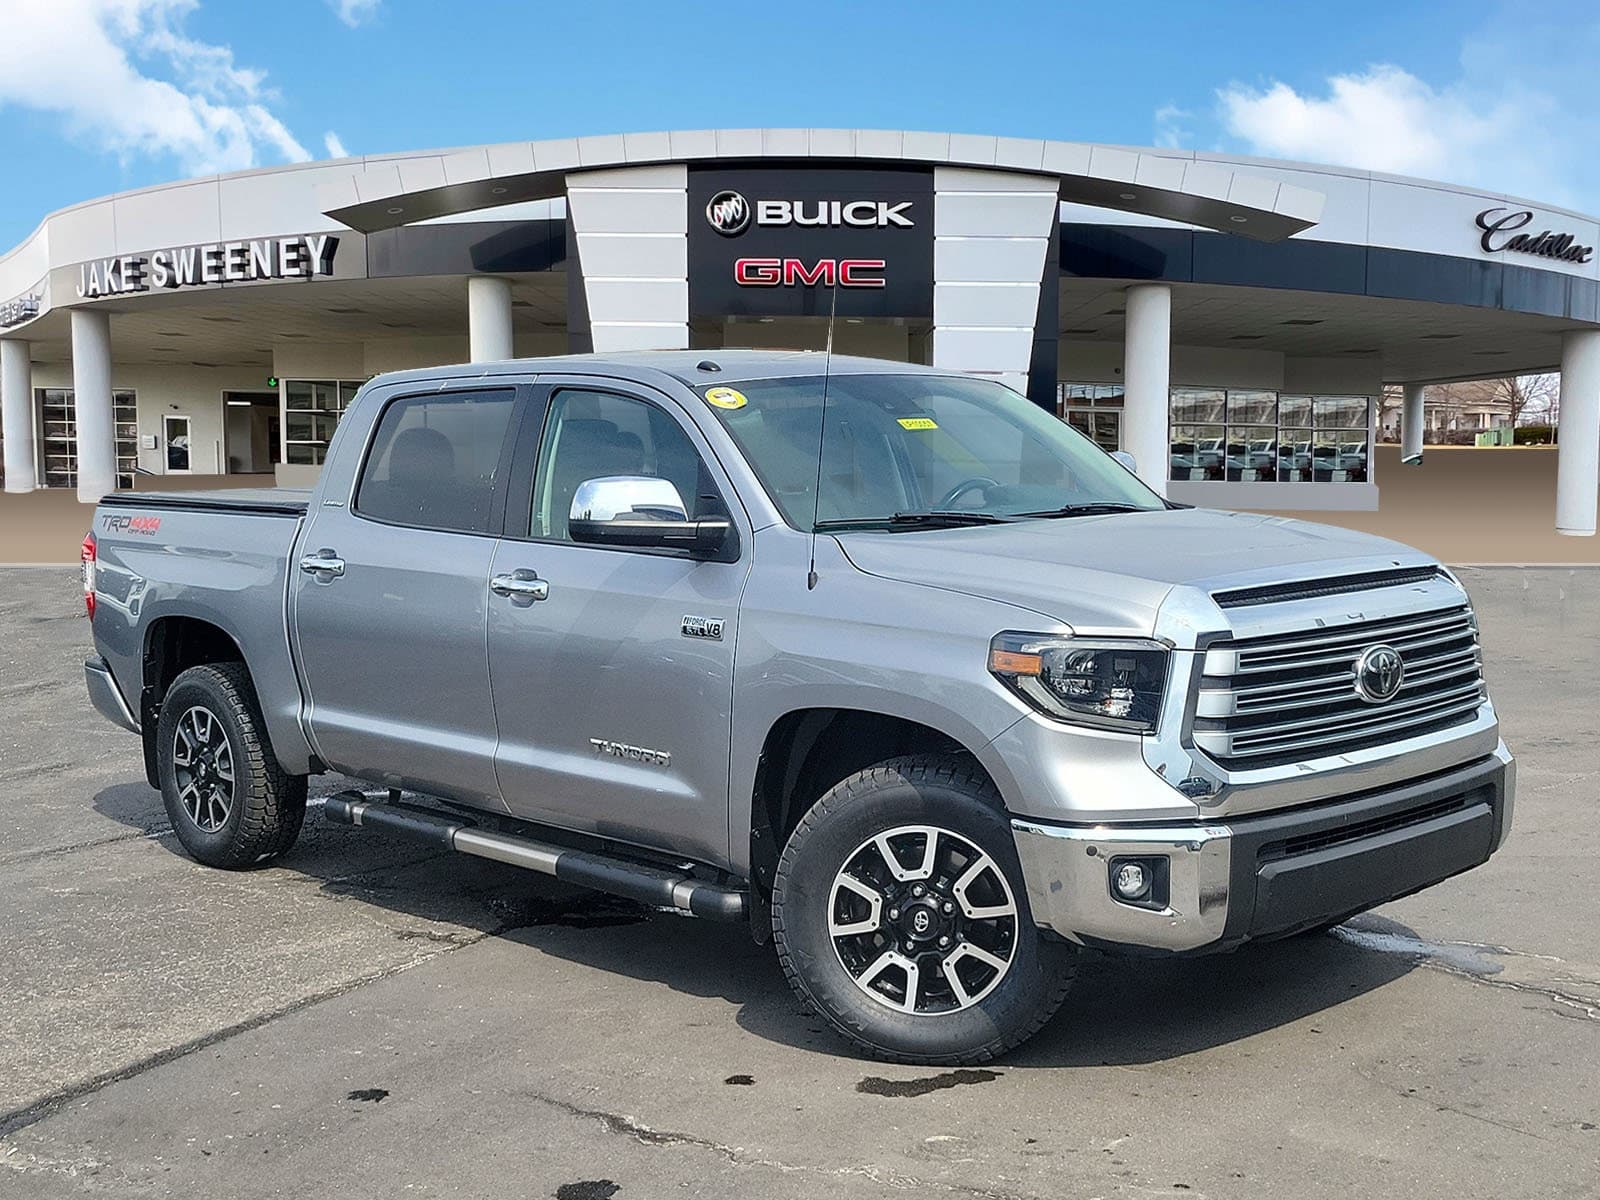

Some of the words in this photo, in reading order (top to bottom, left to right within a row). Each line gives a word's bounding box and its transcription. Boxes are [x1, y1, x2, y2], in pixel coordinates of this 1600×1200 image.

[757, 200, 915, 226] BUICK
[1475, 207, 1593, 264] Cadillac
[76, 256, 142, 298] JAKE
[151, 234, 334, 288] SWEENEY
[735, 258, 886, 286] GMC
[102, 514, 132, 532] TRD
[706, 622, 722, 636] V8
[589, 738, 671, 767] TUNDRA
